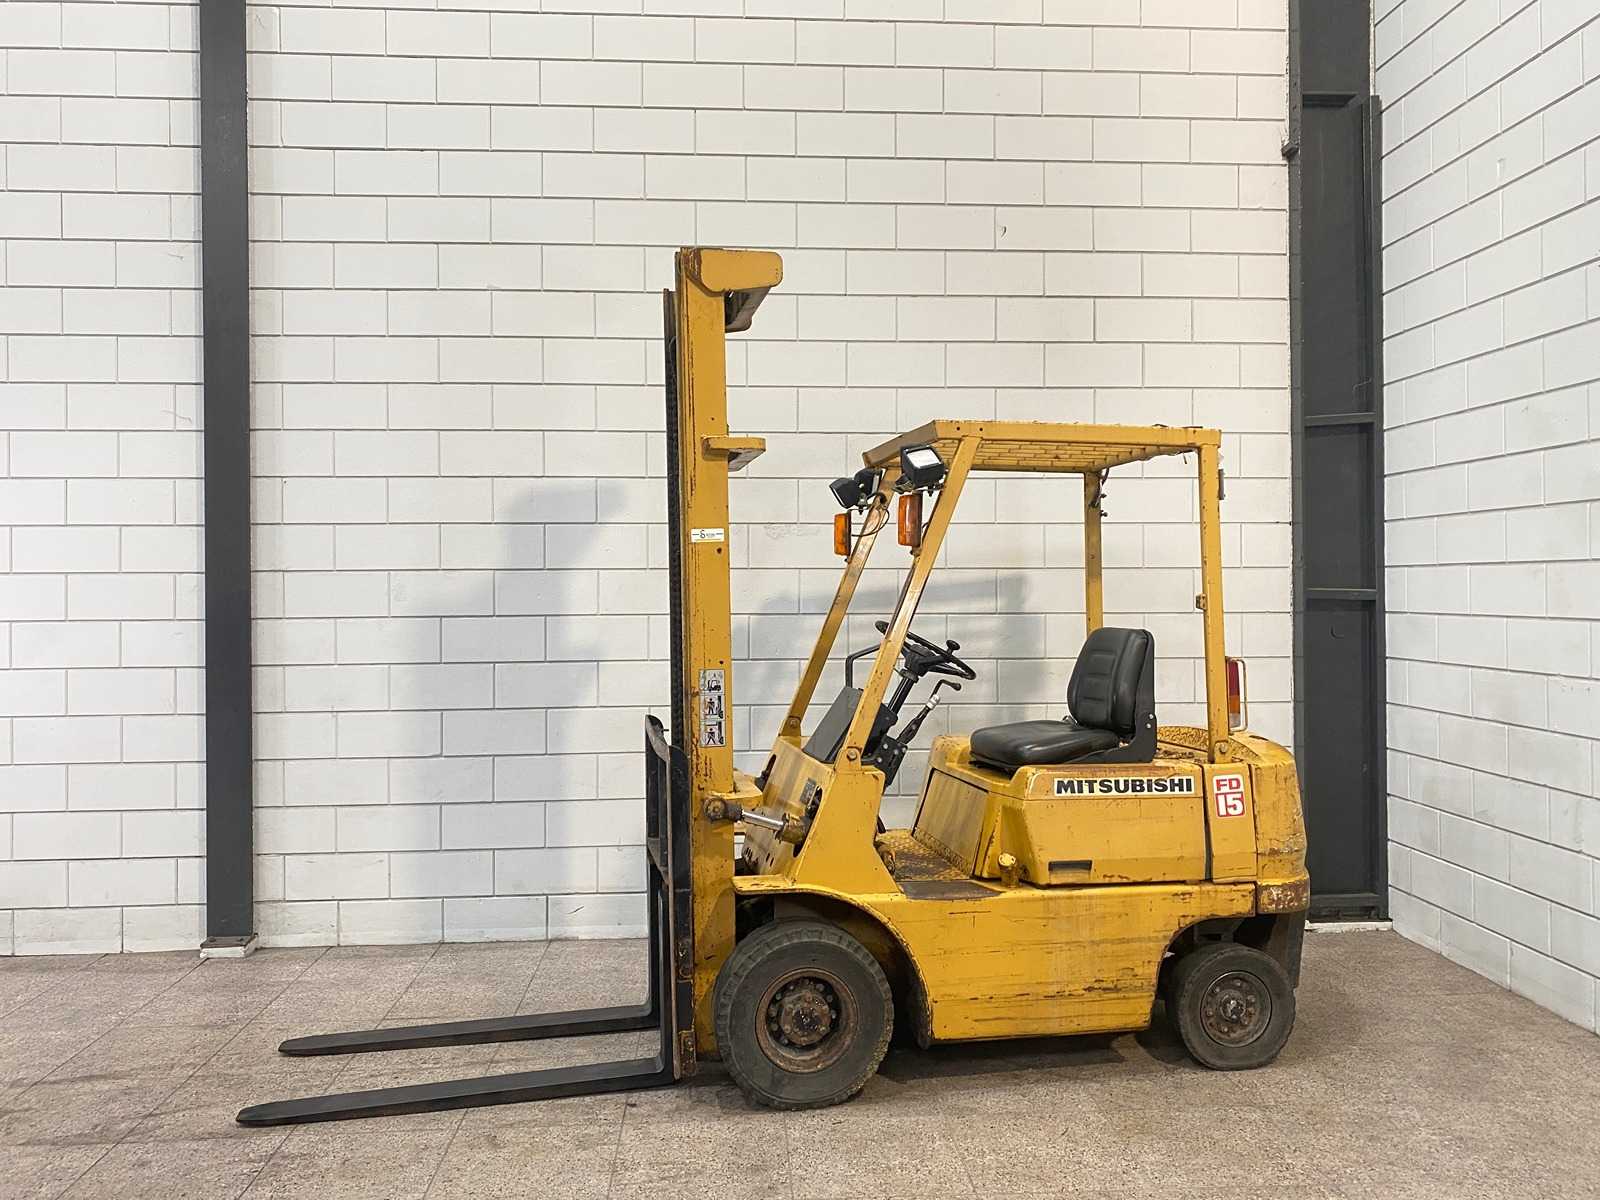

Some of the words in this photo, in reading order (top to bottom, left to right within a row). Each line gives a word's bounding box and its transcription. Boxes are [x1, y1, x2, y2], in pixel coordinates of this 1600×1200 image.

[1056, 778, 1192, 794] MITSUBISHI
[1215, 778, 1241, 791] FD
[1217, 793, 1244, 816] 15
